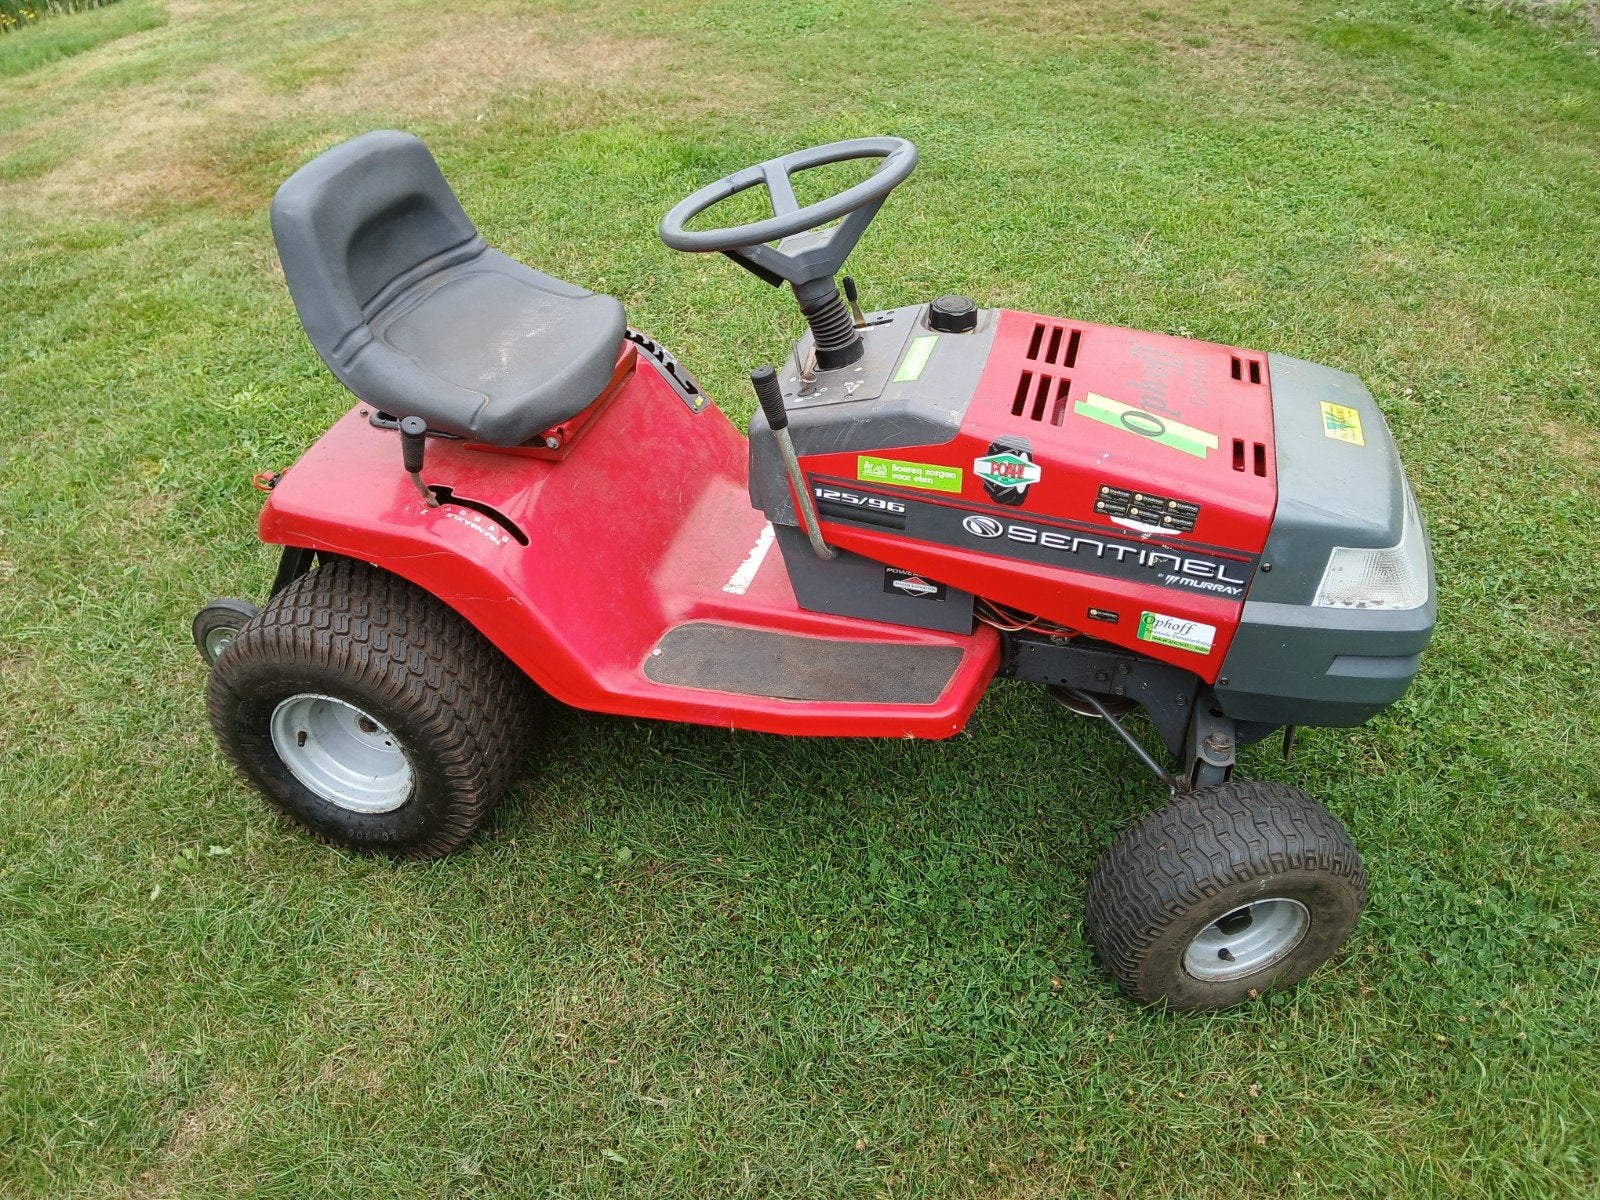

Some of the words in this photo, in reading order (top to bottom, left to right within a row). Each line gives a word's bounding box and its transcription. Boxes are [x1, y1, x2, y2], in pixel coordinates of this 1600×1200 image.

[891, 463, 923, 475] Boeren
[925, 469, 957, 479] zorgen
[891, 473, 911, 482] voor
[913, 475, 934, 485] eten
[813, 487, 906, 513] 125/96
[1007, 526, 1244, 583] SENTINEL
[1143, 614, 1198, 636] Ophoff
